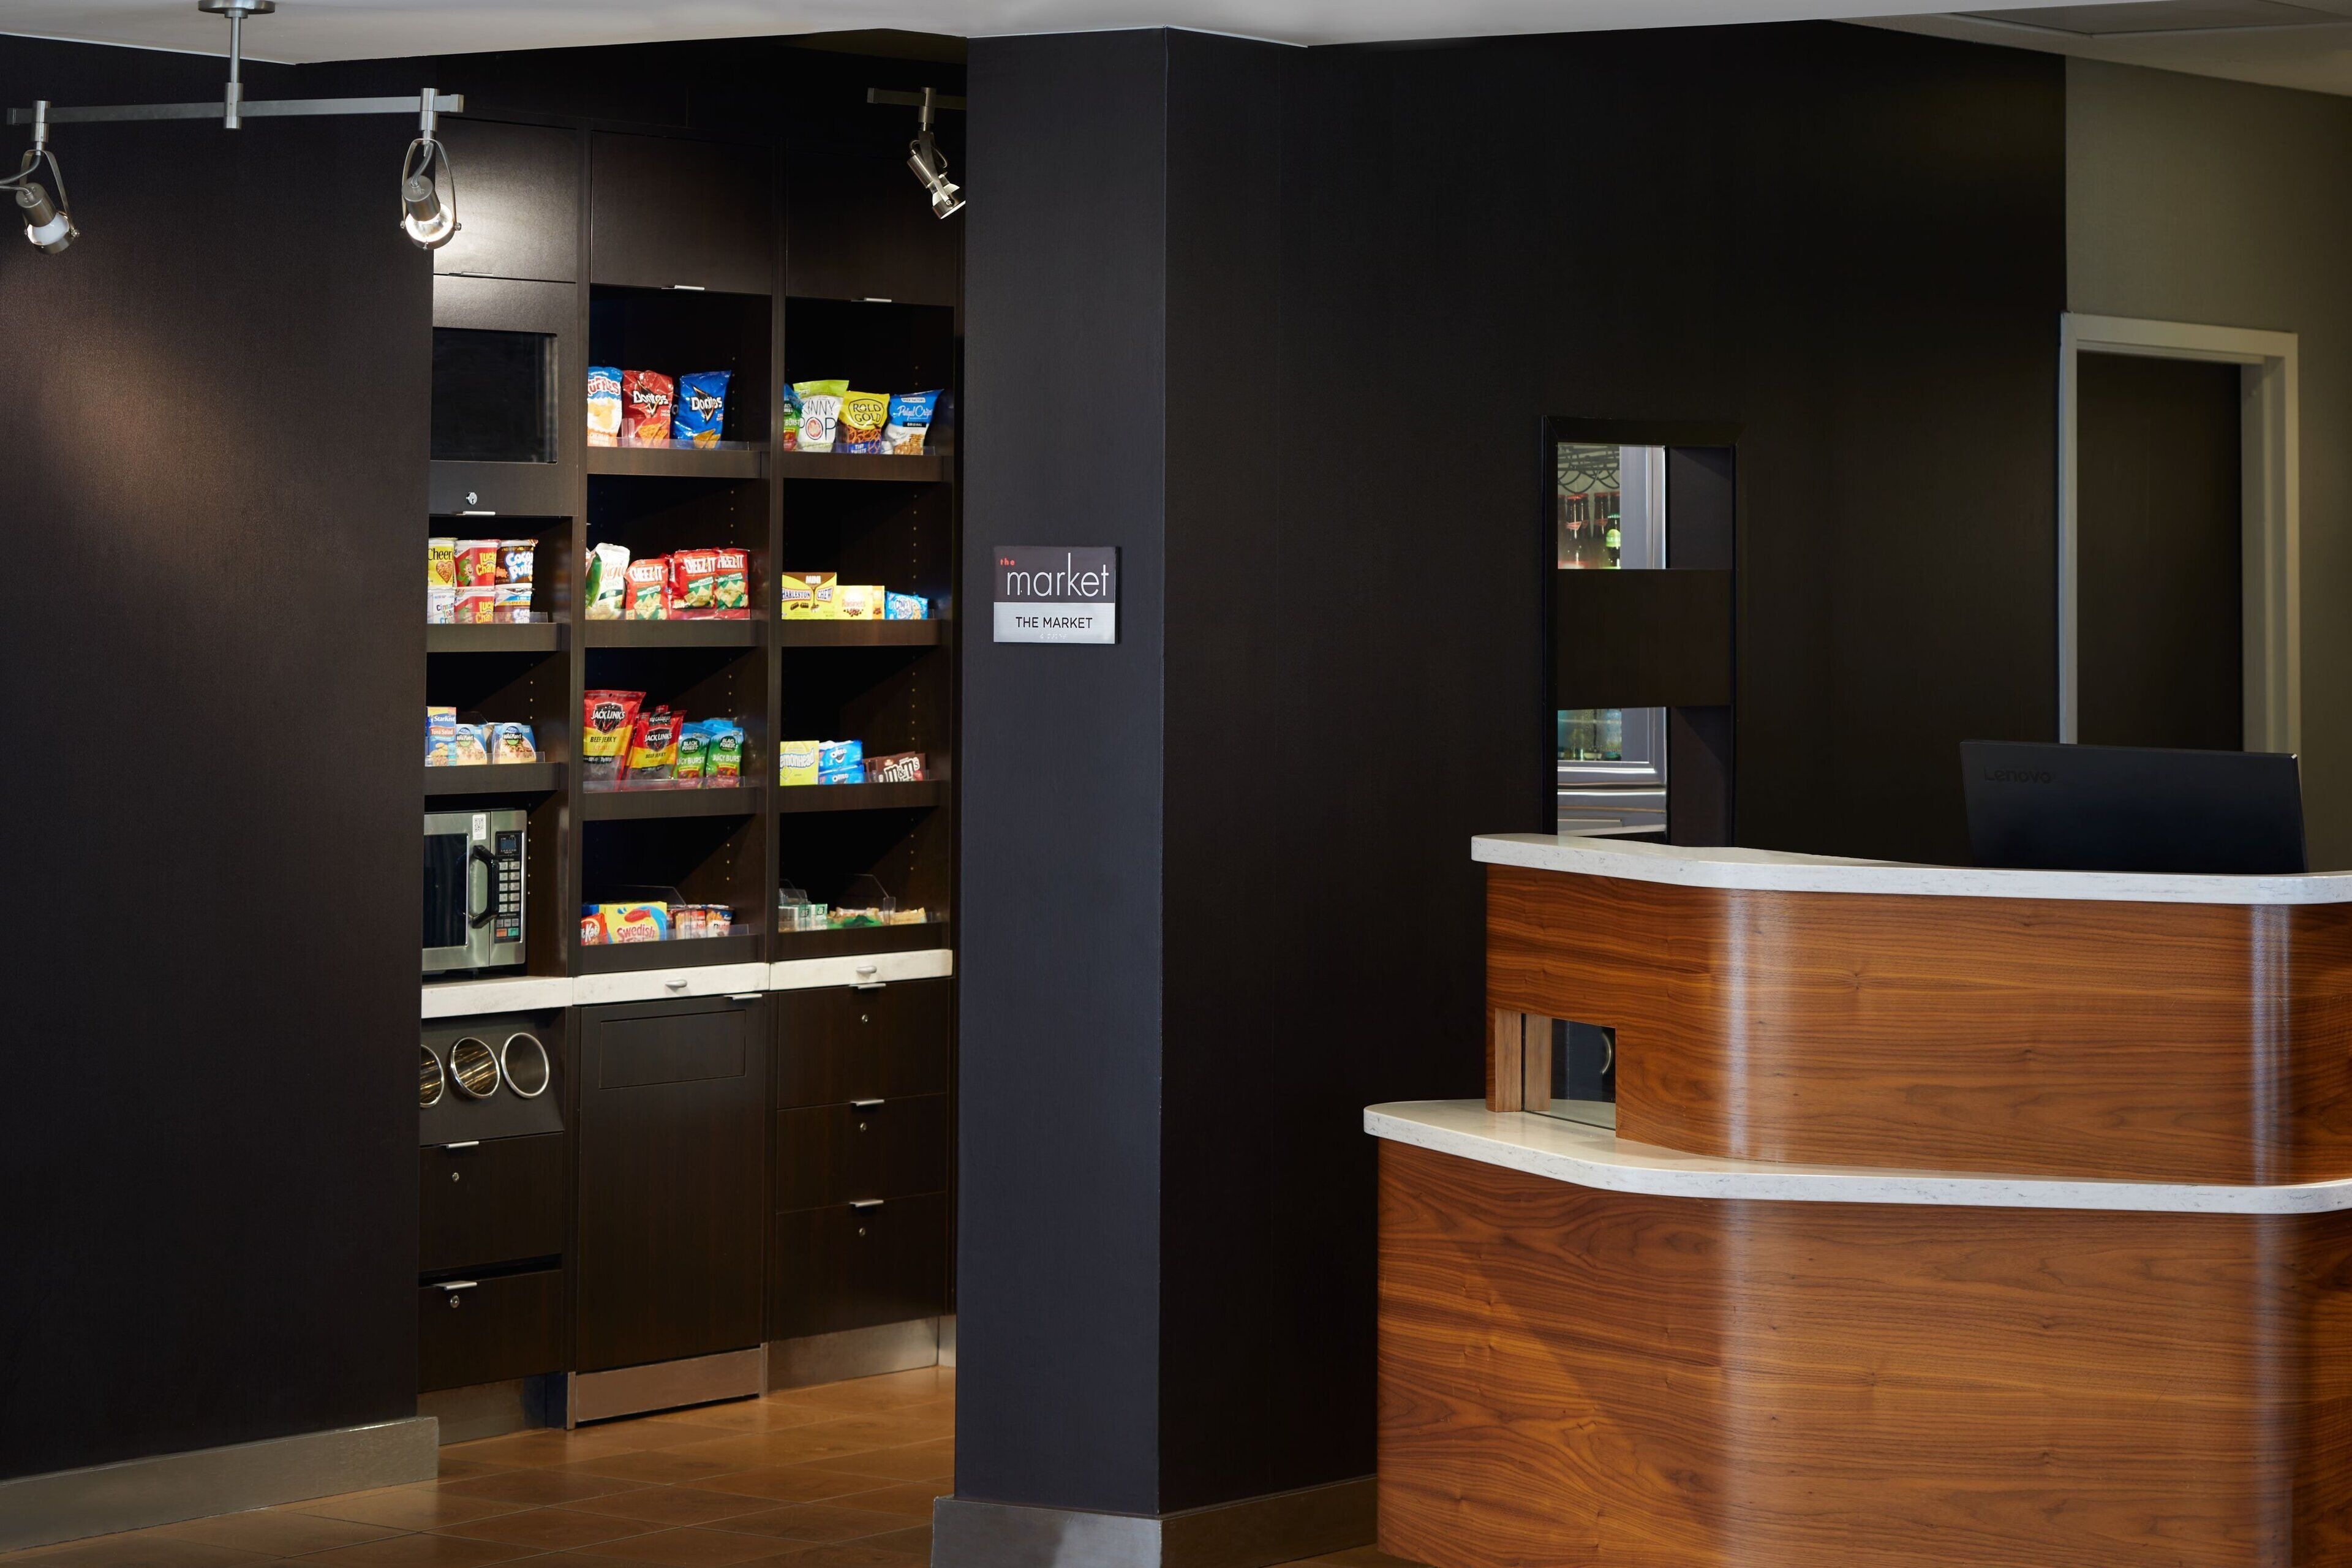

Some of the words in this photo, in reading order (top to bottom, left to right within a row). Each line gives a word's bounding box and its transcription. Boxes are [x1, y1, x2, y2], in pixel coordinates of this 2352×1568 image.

[633, 390, 668, 405] Doritos
[691, 397, 722, 410] Doritos
[802, 400, 835, 415] KINNY
[853, 404, 881, 413] ROLD
[855, 413, 880, 422] GOLD
[1000, 557, 1015, 565] the
[1007, 552, 1109, 597] market
[782, 589, 810, 600] HARLESTON
[816, 589, 832, 599] CHEW
[1016, 616, 1039, 628] THE
[1042, 617, 1093, 628] MARKET
[591, 709, 607, 720] JACK
[1983, 765, 2052, 784] Lenovo
[617, 924, 655, 941] Swedish
